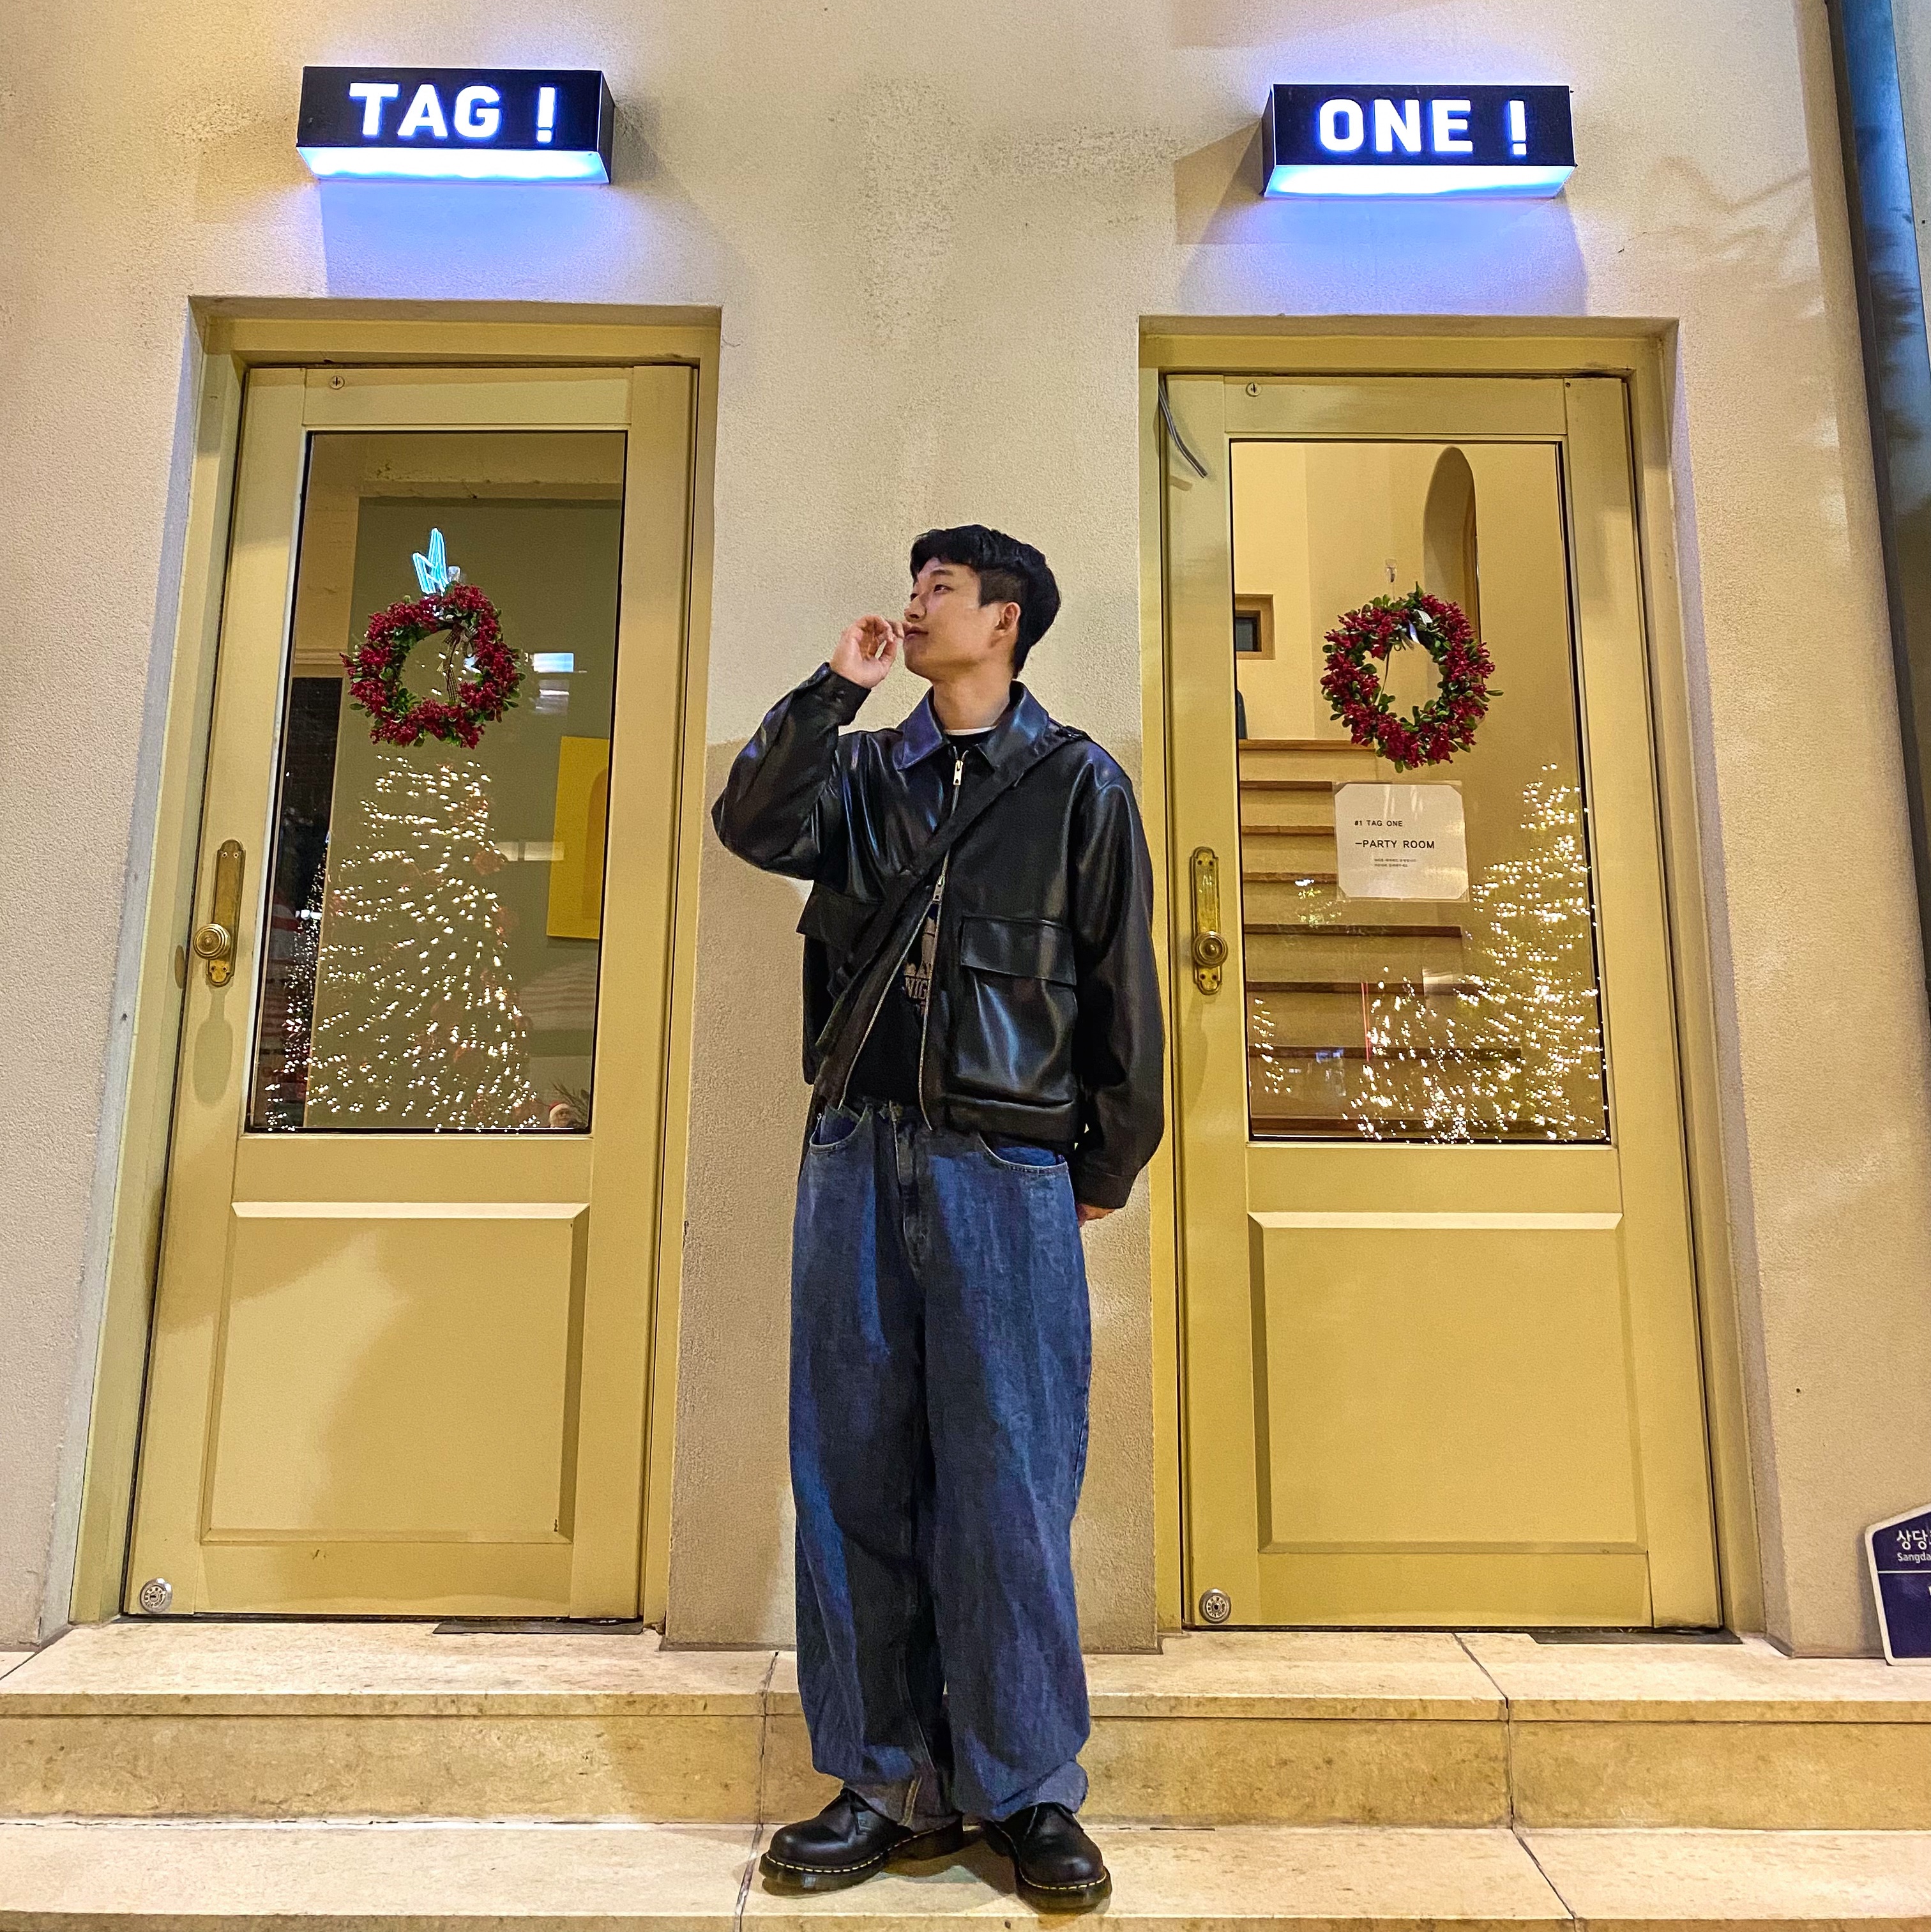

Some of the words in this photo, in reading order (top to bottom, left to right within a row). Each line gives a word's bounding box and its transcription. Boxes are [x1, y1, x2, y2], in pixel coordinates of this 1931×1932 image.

[348, 82, 501, 139] TAG
[536, 86, 556, 144] !
[1317, 98, 1474, 153] ONE
[1508, 99, 1527, 156] !
[1403, 840, 1435, 849] ROOM
[1897, 1529, 1931, 1551] 상당
